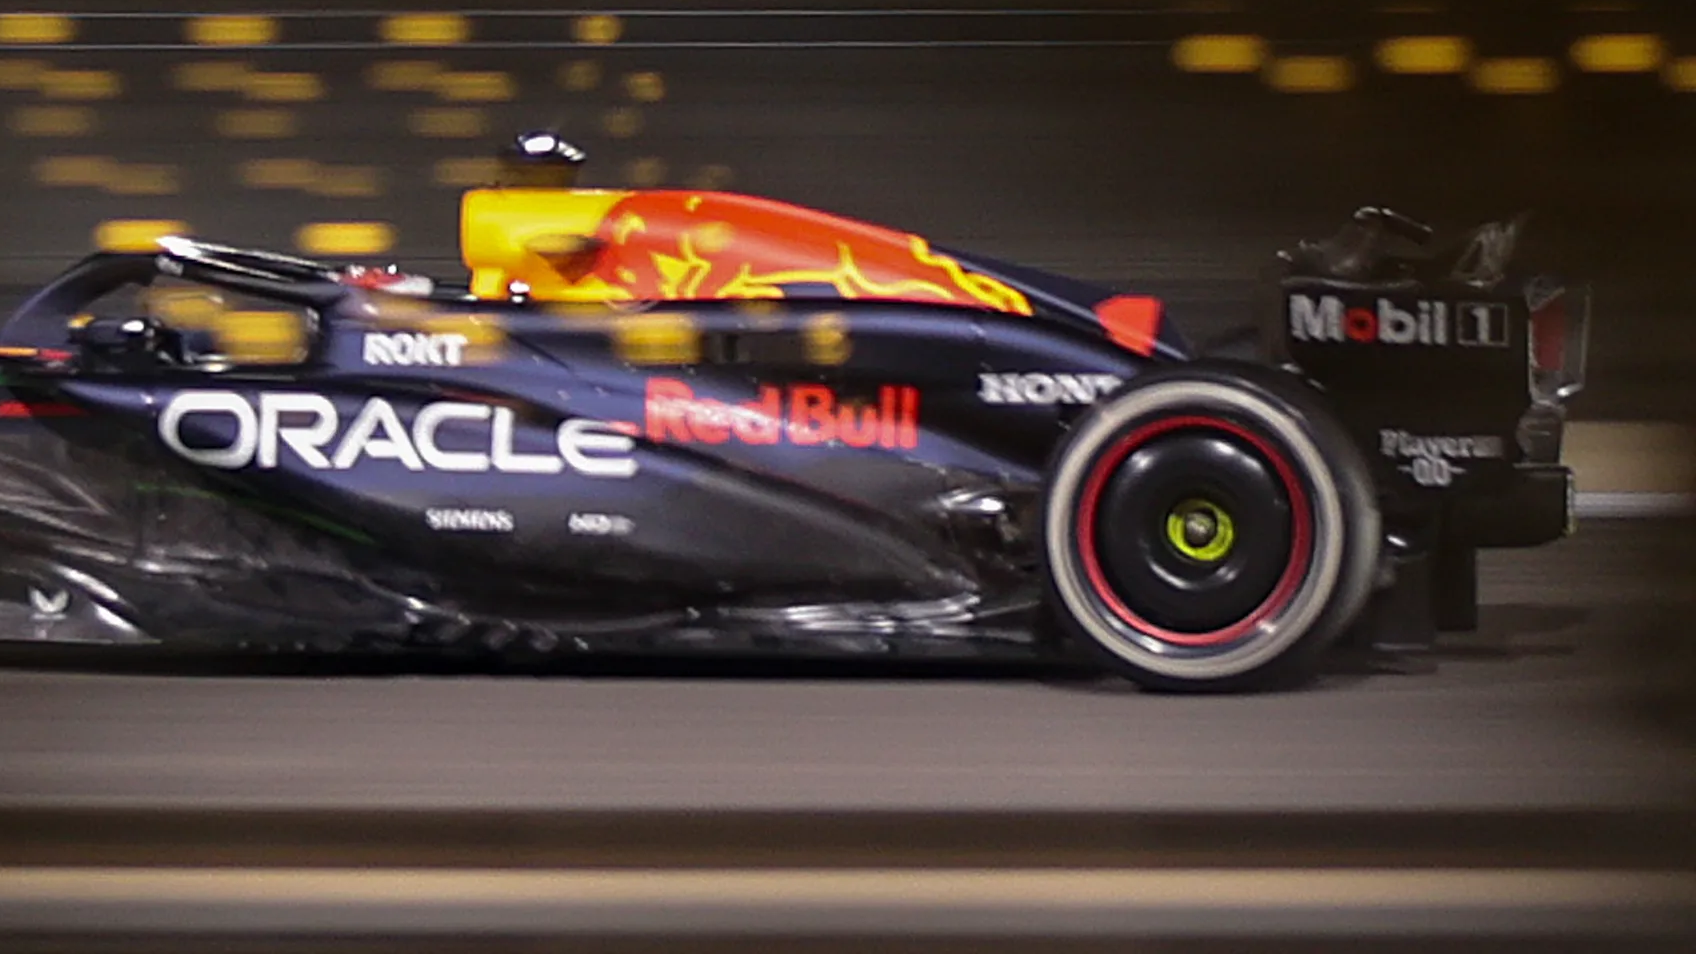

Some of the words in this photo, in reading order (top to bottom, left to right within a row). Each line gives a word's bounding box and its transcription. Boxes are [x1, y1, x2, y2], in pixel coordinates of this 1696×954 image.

[1289, 294, 1448, 344] Mobil
[1472, 306, 1490, 343] 1
[158, 390, 639, 478] ORACLE
[645, 377, 781, 444] Red
[787, 383, 920, 449] Bull
